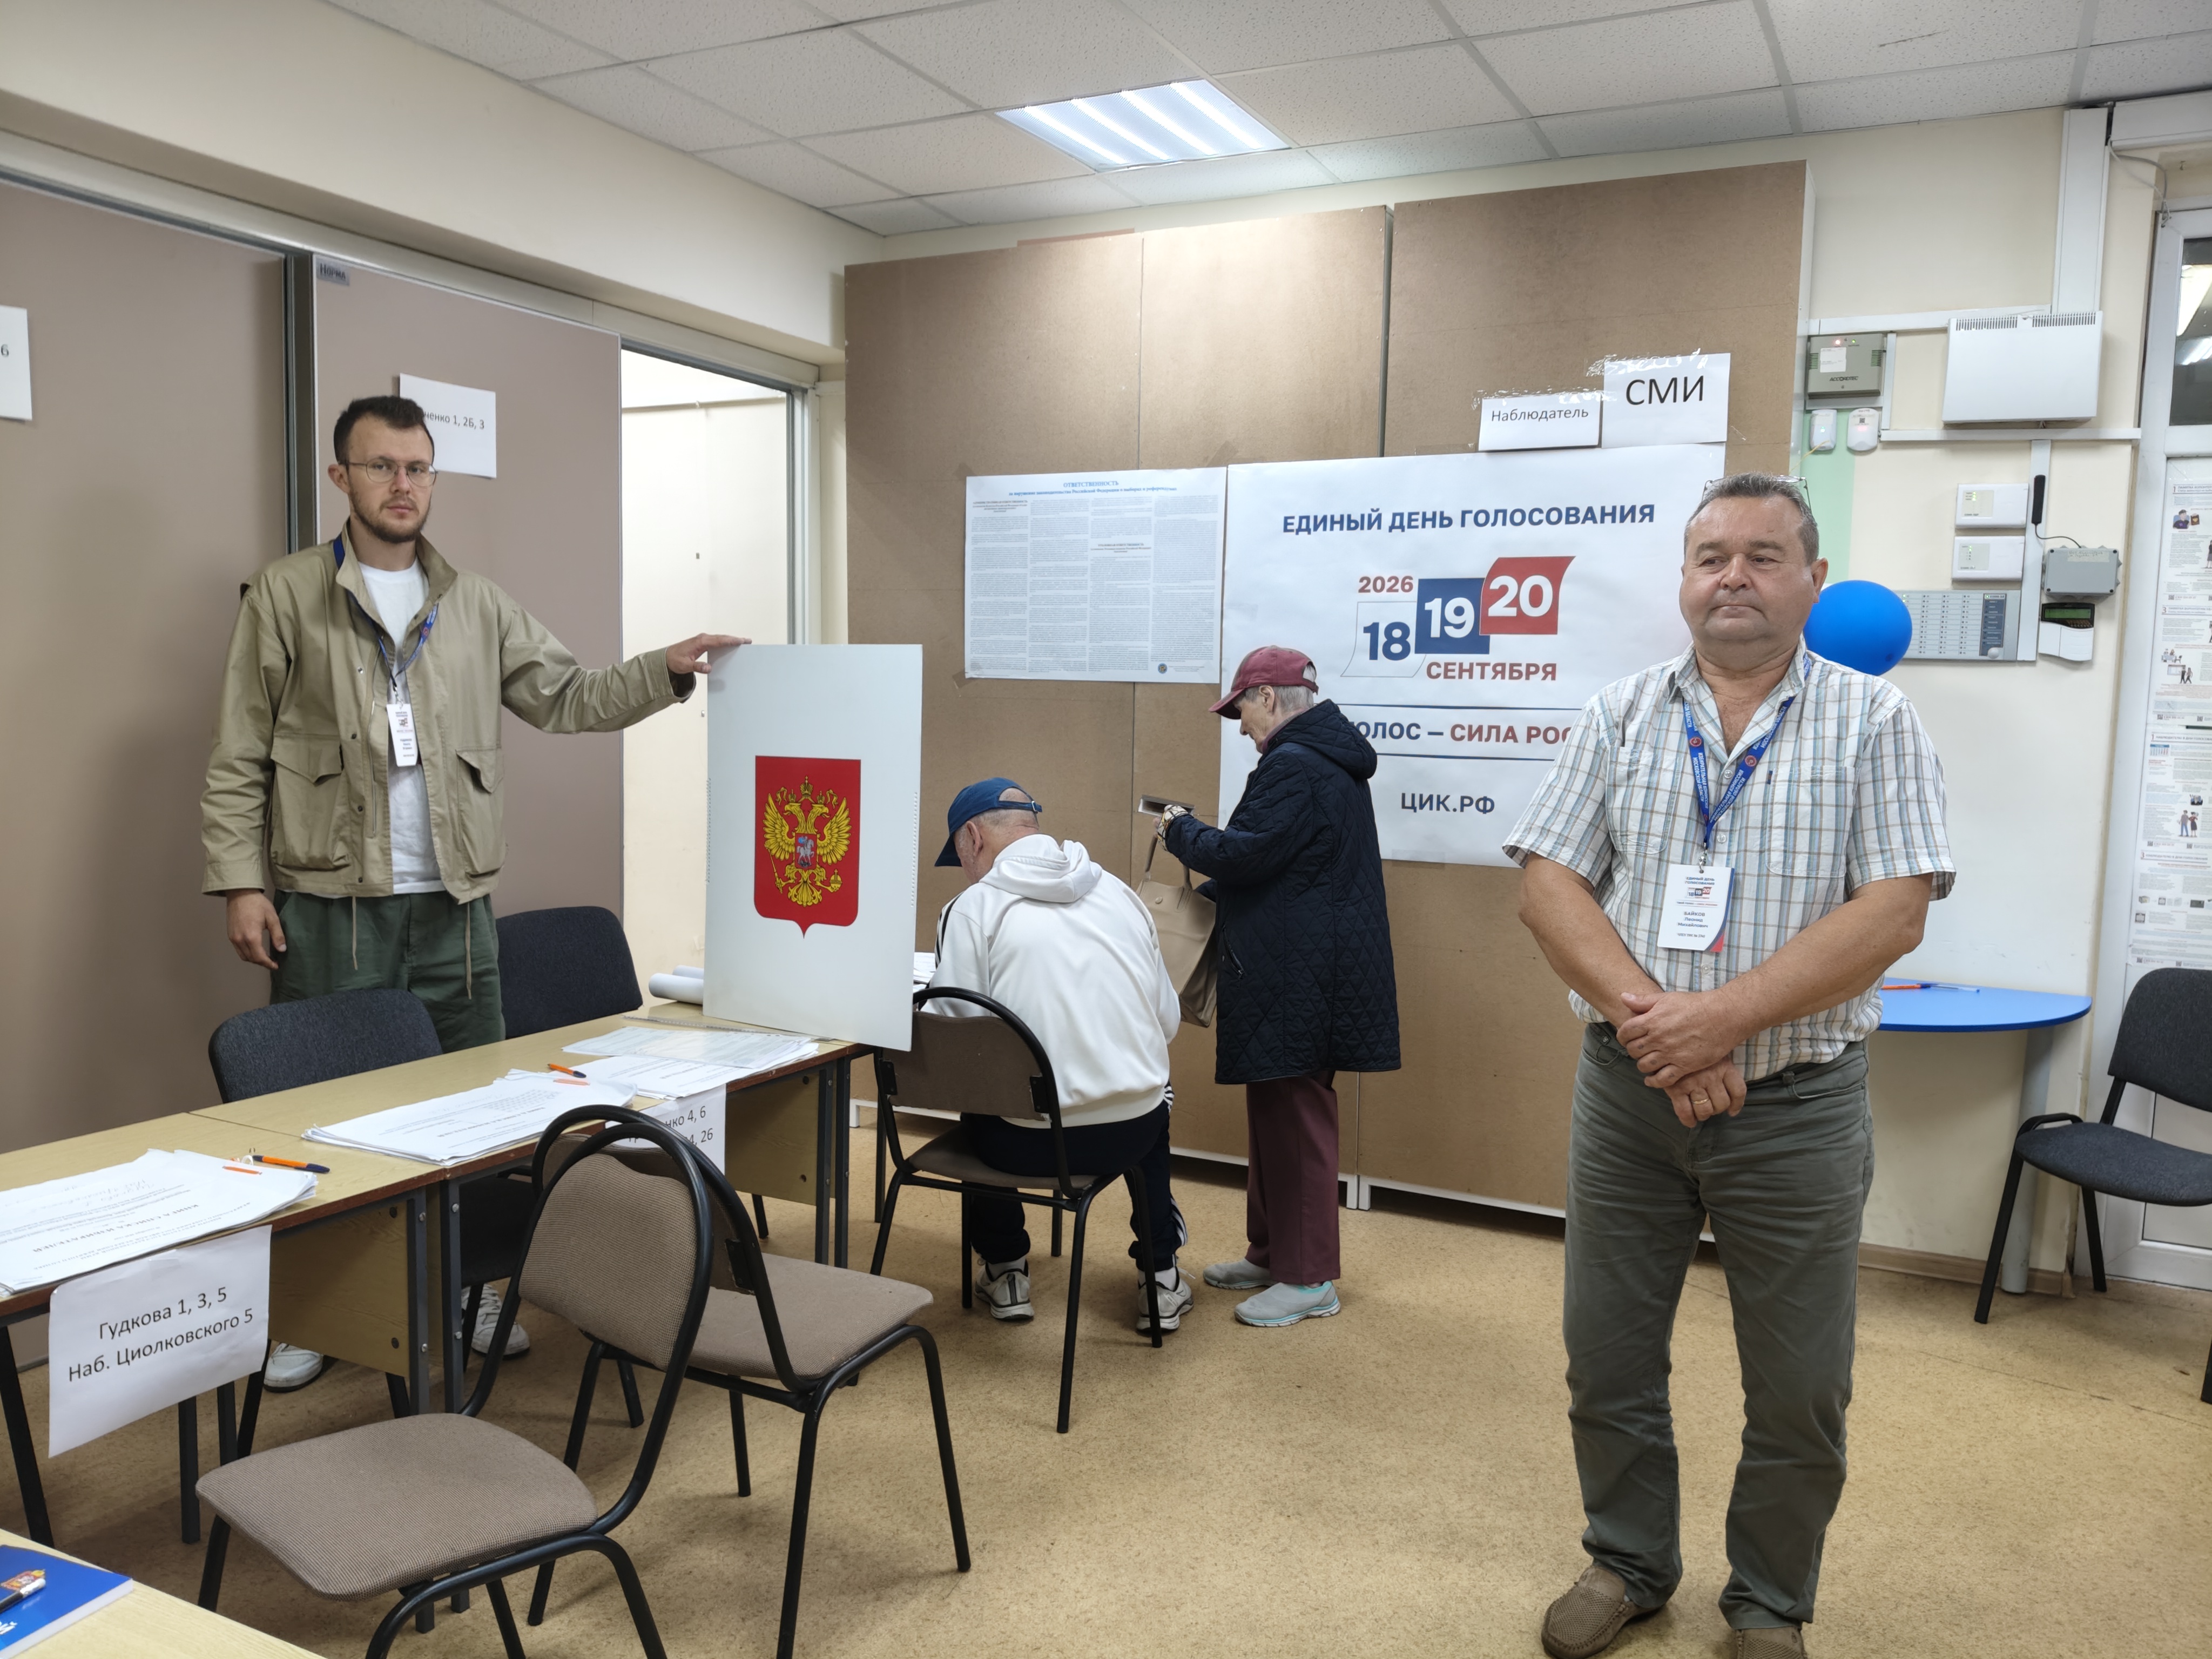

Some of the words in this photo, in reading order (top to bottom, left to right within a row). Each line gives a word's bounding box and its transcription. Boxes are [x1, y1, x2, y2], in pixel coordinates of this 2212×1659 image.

[1625, 375, 1704, 406] СМИ
[424, 411, 450, 424] ченко
[453, 415, 460, 427] 1,
[480, 419, 484, 429] 3
[1491, 407, 1589, 424] Наблюдатель
[1283, 507, 1383, 535] ЕДИНЫЙ
[1388, 510, 1453, 533] ДЕНЬ
[1460, 504, 1655, 528] ГОЛОСОВАНИЯ
[1358, 576, 1414, 593] 2026
[1363, 622, 1411, 661] 18
[1425, 597, 1475, 638] 19
[1488, 575, 1553, 617] 20
[1426, 662, 1557, 680] СЕНТЯБРЯ
[1350, 721, 1421, 740] ОЛОС
[1450, 724, 1519, 743] СИЛА
[1692, 757, 1701, 784] МОСКОВСКОЙ
[1698, 752, 1707, 785] ИЗБИРАТЕЛЬНАЯ
[1401, 792, 1495, 814] ЦИК.РФ
[1710, 791, 1732, 823] ИЗБИРАТЕЛЬНАЯ
[1729, 769, 1744, 792] КОМИССИЯ
[1714, 795, 1735, 821] МОСКОВСКОЙ
[1733, 777, 1746, 797] ОБЛАСТИ
[687, 1110, 697, 1123] 4,
[700, 1105, 706, 1118] 6
[701, 1128, 713, 1143] 26
[99, 1306, 171, 1339] Гудкова
[178, 1299, 192, 1315] 1,
[198, 1293, 212, 1309] 3,
[218, 1287, 226, 1303] 5
[69, 1355, 110, 1382] Наб.
[117, 1316, 239, 1367] Циолковского
[244, 1309, 253, 1323] 5
